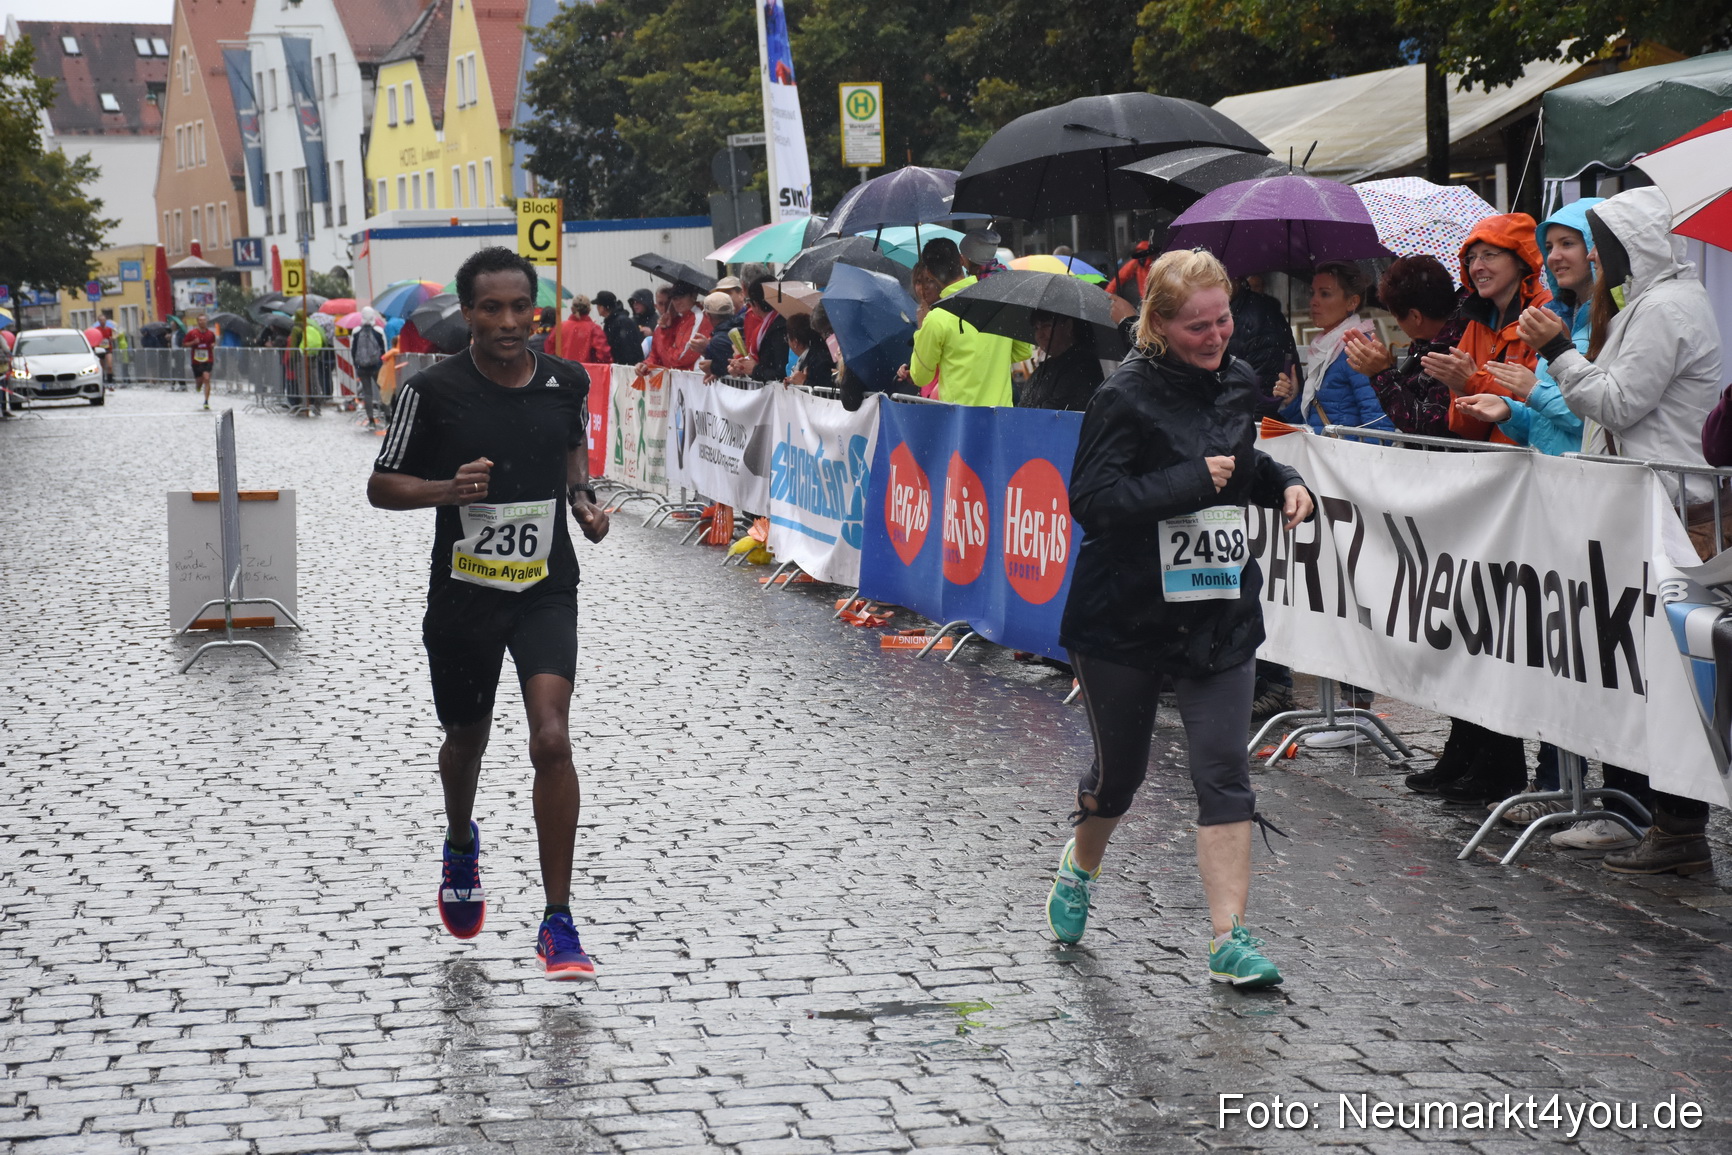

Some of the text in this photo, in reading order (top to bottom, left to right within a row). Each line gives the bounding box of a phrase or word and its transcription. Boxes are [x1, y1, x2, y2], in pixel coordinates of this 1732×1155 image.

[522, 201, 557, 214] Block
[528, 218, 551, 252] C
[288, 270, 299, 288] D
[503, 504, 549, 519] BOCK
[1203, 509, 1242, 521] BOCK
[473, 523, 539, 558] 236
[1005, 486, 1067, 577] Hervis
[1170, 528, 1245, 566] 2498
[175, 558, 207, 570] Runde
[246, 555, 273, 568] Ziel
[458, 557, 542, 581] Girma Ayalew
[1008, 561, 1040, 581] SPORTS
[1191, 573, 1238, 586] Monika
[1382, 513, 1657, 703] Neumarkt
